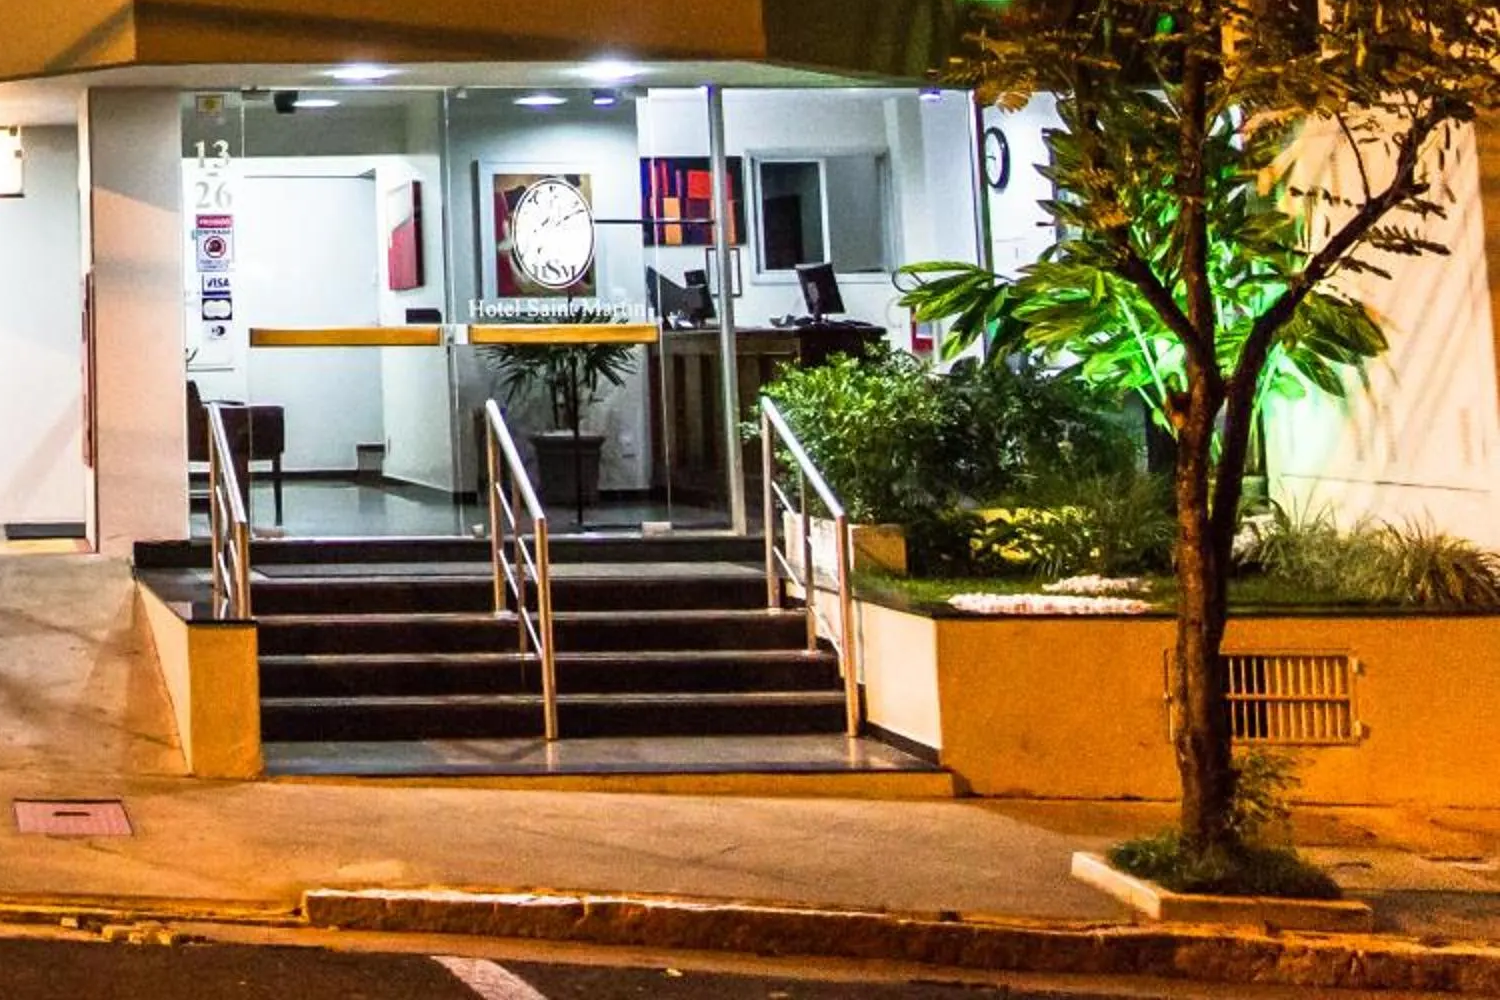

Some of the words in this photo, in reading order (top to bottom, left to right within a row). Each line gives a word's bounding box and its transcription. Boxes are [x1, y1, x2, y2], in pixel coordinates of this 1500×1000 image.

[194, 139, 230, 169] 13
[195, 181, 232, 209] 26
[206, 277, 230, 288] VISA
[468, 299, 520, 317] Hotel
[528, 299, 577, 317] Saint
